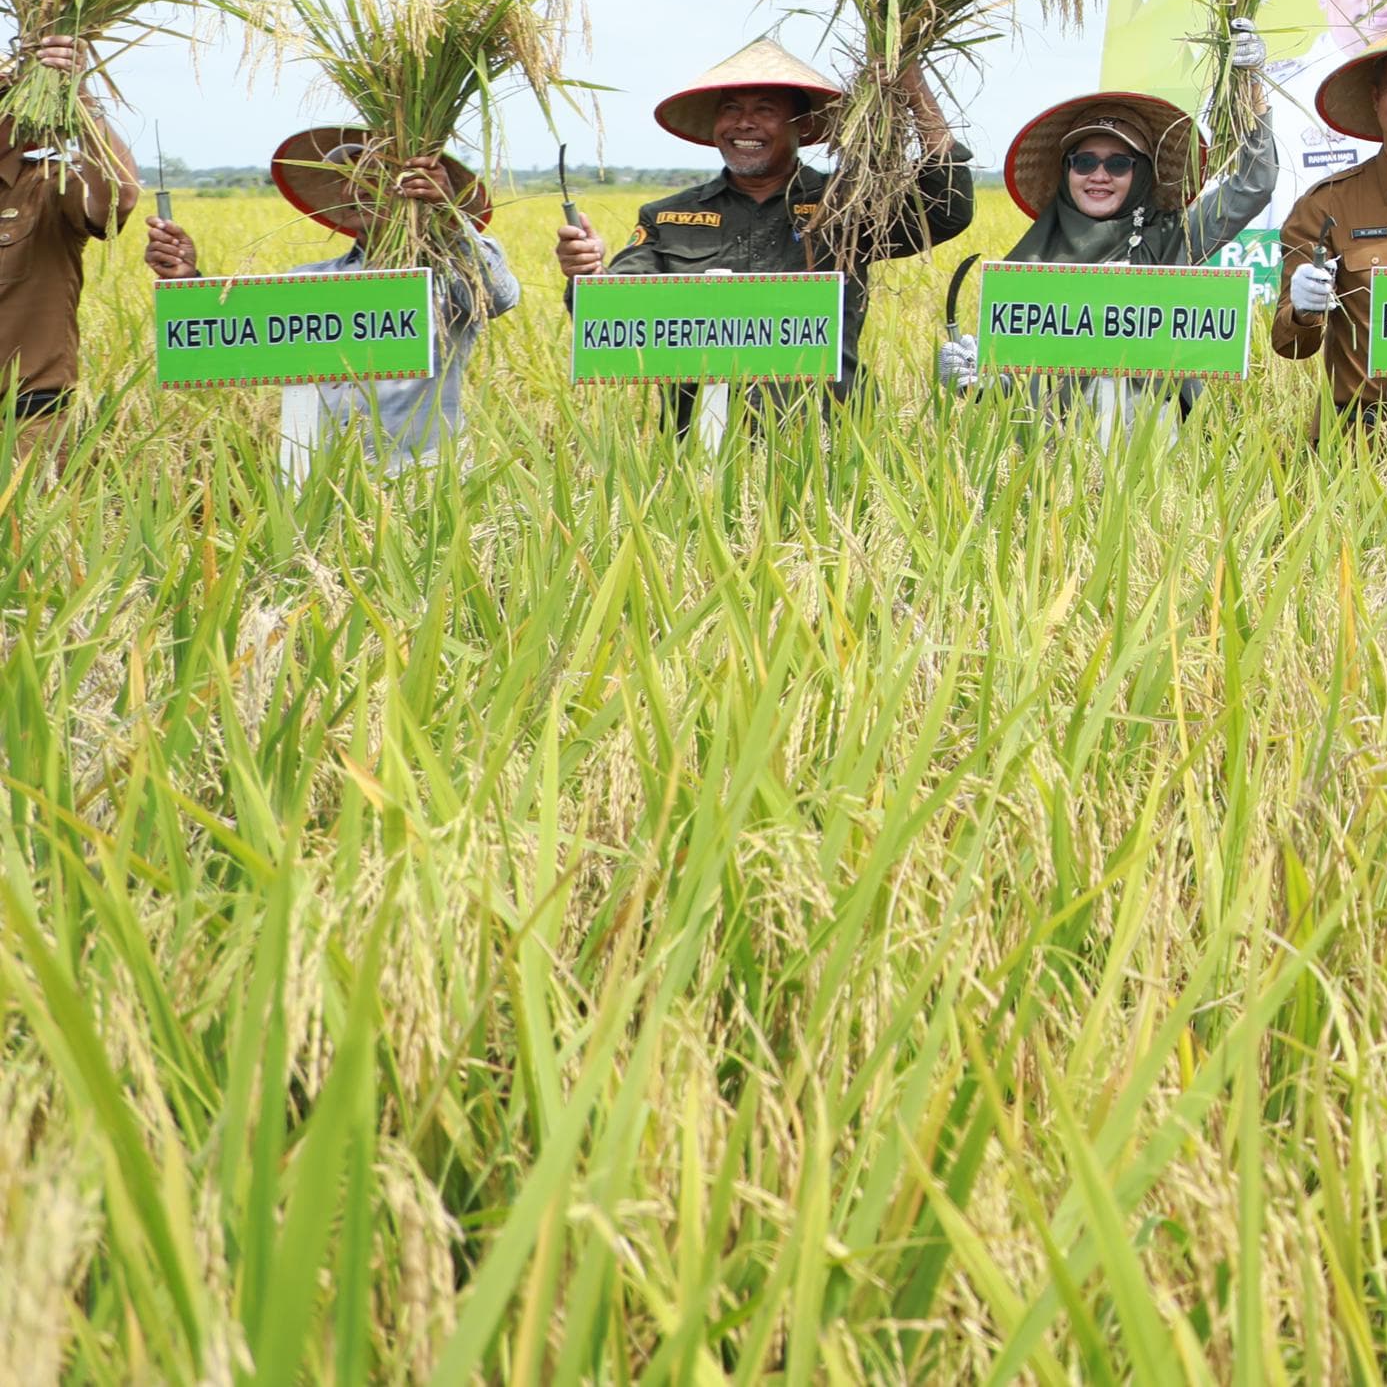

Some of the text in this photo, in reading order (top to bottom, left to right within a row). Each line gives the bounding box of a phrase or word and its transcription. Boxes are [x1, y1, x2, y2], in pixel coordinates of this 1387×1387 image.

[166, 309, 418, 349] KETUA DPRD SIAK
[583, 316, 829, 349] KADIS PERTANIAN SIAK
[990, 302, 1237, 341] KEPALA BSIP RIAU
